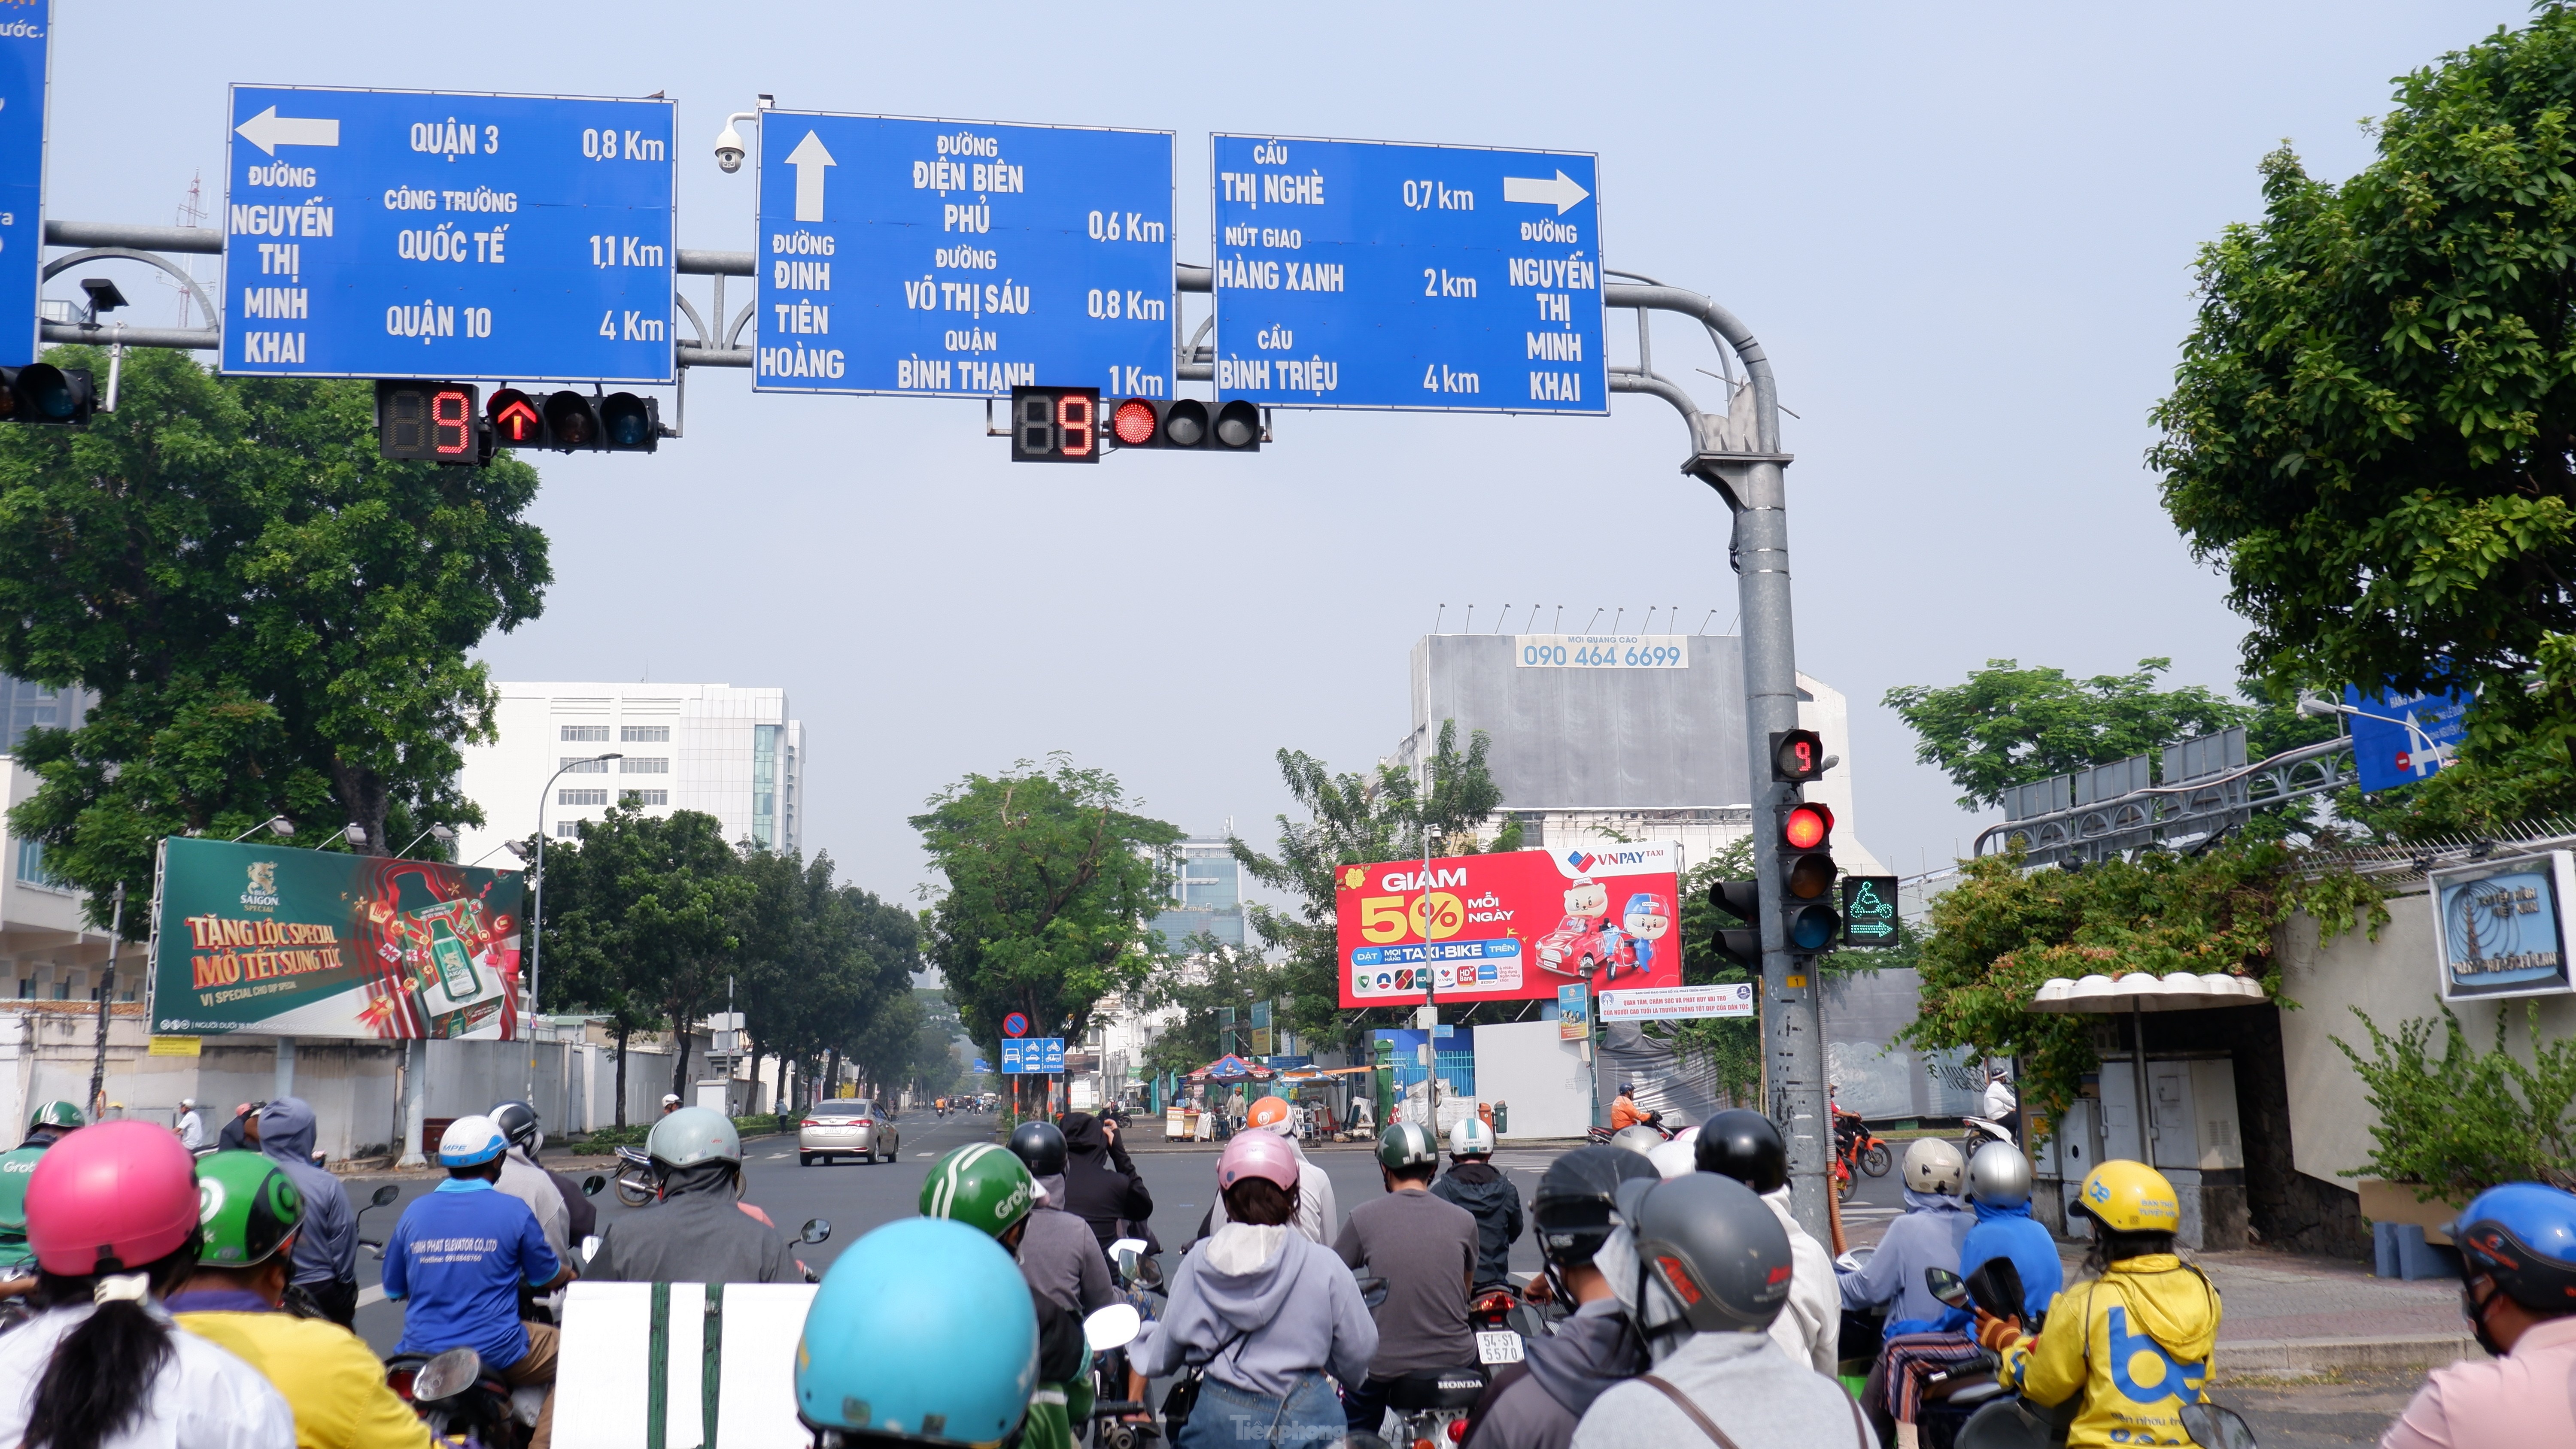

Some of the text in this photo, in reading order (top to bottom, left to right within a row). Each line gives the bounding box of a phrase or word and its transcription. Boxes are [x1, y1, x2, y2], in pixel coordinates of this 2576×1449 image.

[411, 117, 498, 161] QUẬN 3
[583, 129, 664, 161] 0,8 Km
[937, 132, 997, 157] ĐƯỜNG
[1254, 140, 1287, 165] CẦU
[249, 160, 316, 188] ĐƯỜNG
[913, 156, 1023, 197] ĐIỆN BIÊN
[385, 185, 517, 212] CÔNG TRƯỜNG
[1221, 169, 1324, 209] THỊ NGHÈ
[1404, 180, 1473, 210] 0,7 km
[231, 196, 333, 236] NGUYỄN
[945, 195, 990, 233] PHỦ
[1089, 211, 1164, 242] 0,6 Km
[399, 222, 509, 263] QUỐC TẾ
[773, 230, 834, 255] ĐƯỜNG
[1226, 223, 1301, 249] NÚT GIAO
[1521, 220, 1577, 243] ĐƯỜNG
[259, 244, 299, 282] THỊ
[590, 236, 662, 269] 1,1 Km
[936, 244, 996, 269] ĐƯỜNG
[775, 261, 829, 290] ĐINH
[1219, 254, 1343, 291] HÀNG XANH
[1425, 269, 1476, 297] 2 km
[1510, 251, 1594, 289] NGUYỄN
[245, 288, 307, 318] MINH
[905, 275, 1029, 319] VÕ THỊ SÁU
[1088, 289, 1164, 320] 0,8 Km
[1537, 294, 1570, 329] THỊ
[387, 300, 491, 344] QUẬN 10
[600, 311, 663, 341] 4 Km
[775, 299, 828, 334] TIÊN
[246, 332, 305, 363] KHAI
[945, 327, 996, 355] QUẬN
[1258, 326, 1292, 349] CẦU
[1527, 332, 1581, 361] MINH
[761, 341, 844, 378] HOÀNG
[898, 353, 1034, 393] BÌNH THẠNH
[1109, 366, 1162, 396] 1 Km
[1219, 354, 1337, 396] BÌNH TRIỆU
[1424, 365, 1479, 393] 4 km
[1531, 372, 1580, 401] KHAI
[432, 391, 469, 454] 9
[1057, 395, 1092, 455] 9
[1524, 646, 1680, 666] 090 464 6699
[1795, 742, 1812, 772] 9
[1597, 851, 1645, 865] VNPAY
[1382, 864, 1467, 892] GIẢM
[240, 894, 279, 906] SAIGON
[1468, 891, 1499, 909] MỖI
[1468, 909, 1514, 923] NGÀY
[185, 913, 338, 953] TẶNG LỘC SPECIAL
[1357, 953, 1377, 961] ĐẶT
[1385, 944, 1515, 960] MỌI TAXI-BIKE TRÊN
[191, 945, 343, 989] MỞ TẾT SUNG TÚC
[200, 993, 213, 1007] VỊ
[216, 987, 254, 1003] SPECIAL
[253, 985, 268, 996] CHO
[278, 981, 298, 991] SPECIAL
[1794, 978, 1799, 986] 1
[1659, 1005, 1677, 1013] TRUYỀN
[3, 1161, 36, 1173] Grab
[995, 1180, 1028, 1219] Grab
[444, 1237, 474, 1252] ELEVATOR
[420, 1255, 444, 1264] Hotline:
[1486, 1347, 1518, 1361] 5570
[1437, 1379, 1483, 1389] HONDA
[2136, 1416, 2166, 1426] nhau
